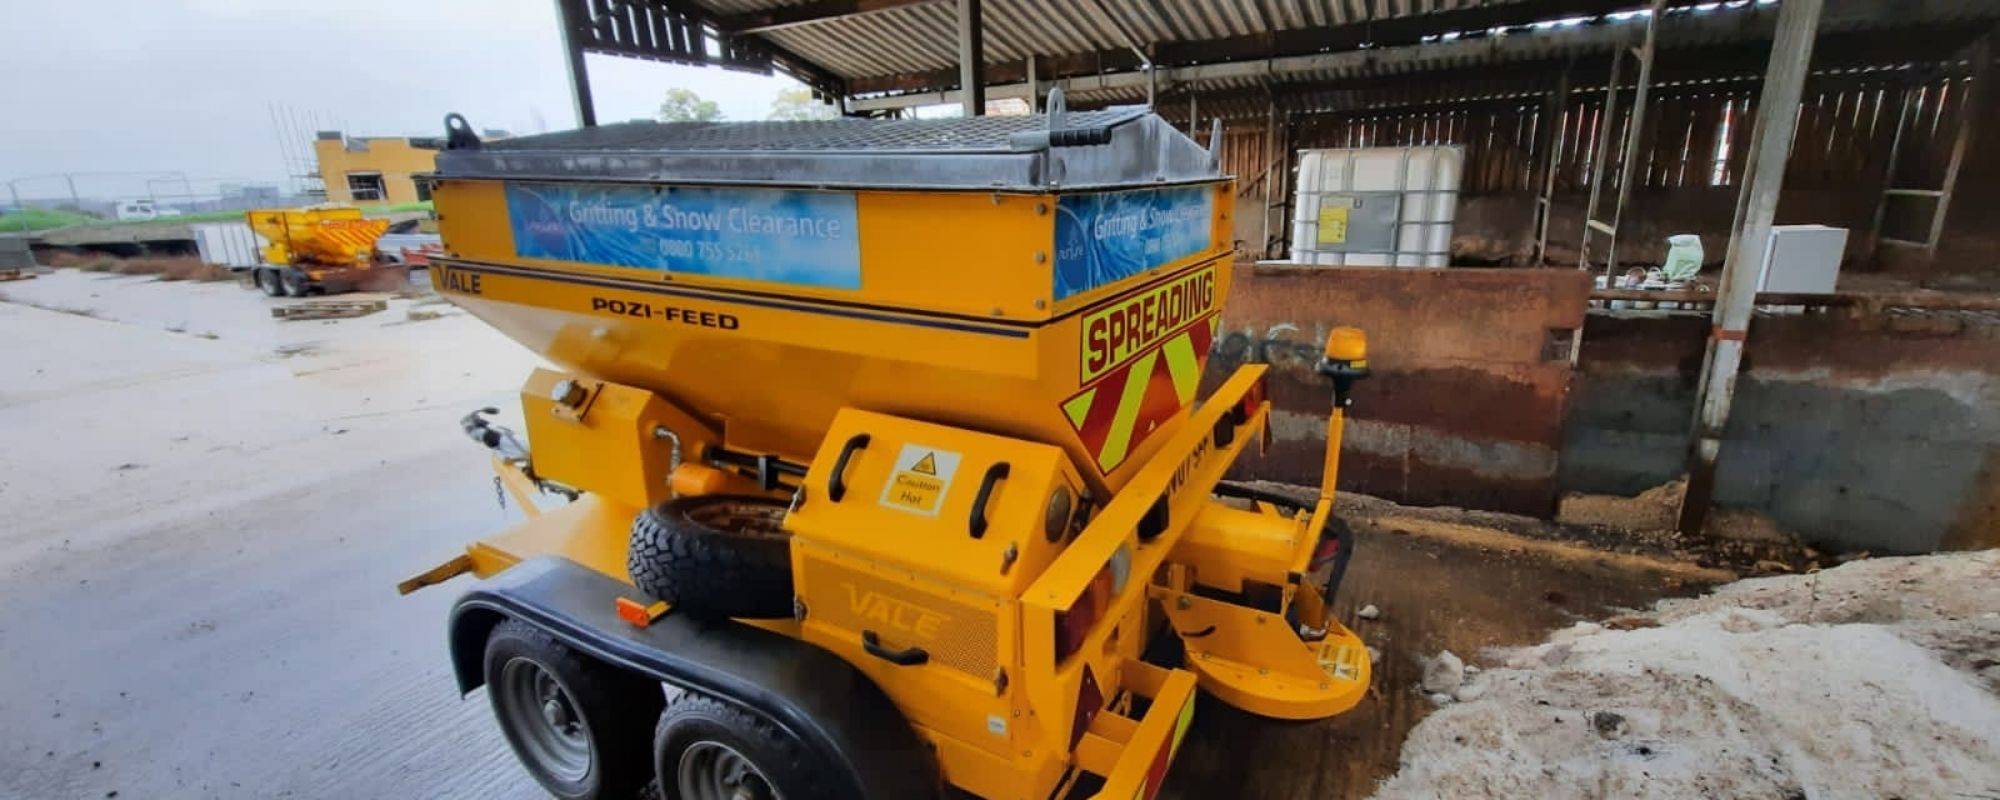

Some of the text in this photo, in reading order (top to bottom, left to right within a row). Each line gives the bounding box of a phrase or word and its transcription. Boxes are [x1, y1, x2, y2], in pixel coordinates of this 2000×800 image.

[569, 200, 640, 232] Gritting
[643, 204, 657, 228] &
[661, 204, 721, 231] Snow
[727, 207, 841, 238] Clearance
[1094, 213, 1138, 240] Gritting
[438, 265, 481, 294] VALE
[591, 297, 739, 330] POZI-FEED
[1088, 270, 1213, 373] SPREADING
[842, 583, 947, 639] VALE
